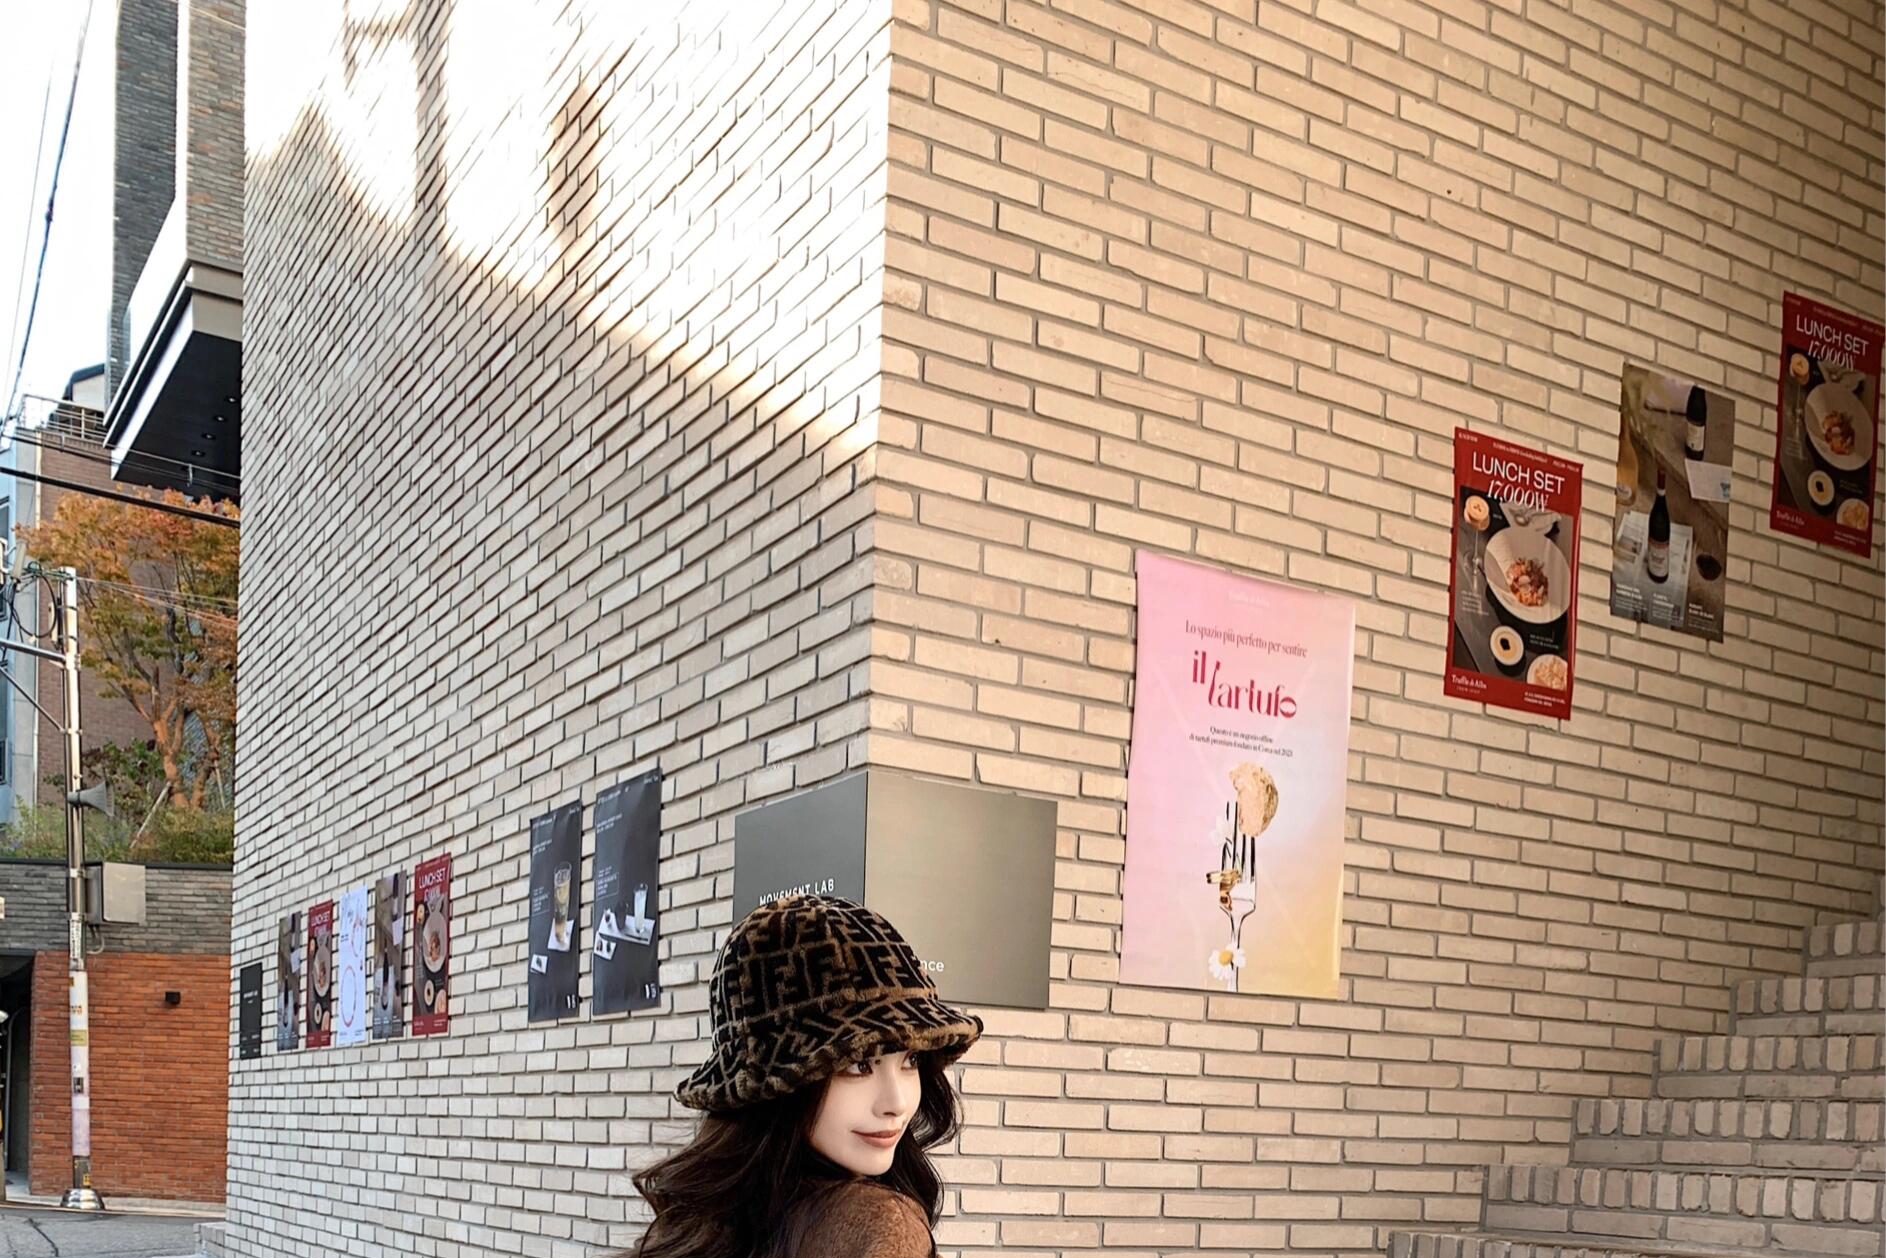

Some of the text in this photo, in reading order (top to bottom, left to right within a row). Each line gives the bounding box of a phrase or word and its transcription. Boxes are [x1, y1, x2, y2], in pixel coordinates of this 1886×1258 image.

[1796, 313, 1842, 347] LUNCH
[1844, 333, 1869, 357] SET
[1472, 450, 1531, 487] LUNCH
[1533, 469, 1565, 495] SET
[1185, 619, 1196, 633] Lo
[1197, 622, 1222, 641] spazio
[1236, 631, 1267, 649] perfetto
[1267, 638, 1281, 655] per
[1281, 643, 1307, 659] sentire
[1193, 650, 1206, 685] il
[759, 878, 835, 906] MOVEMENT LAB
